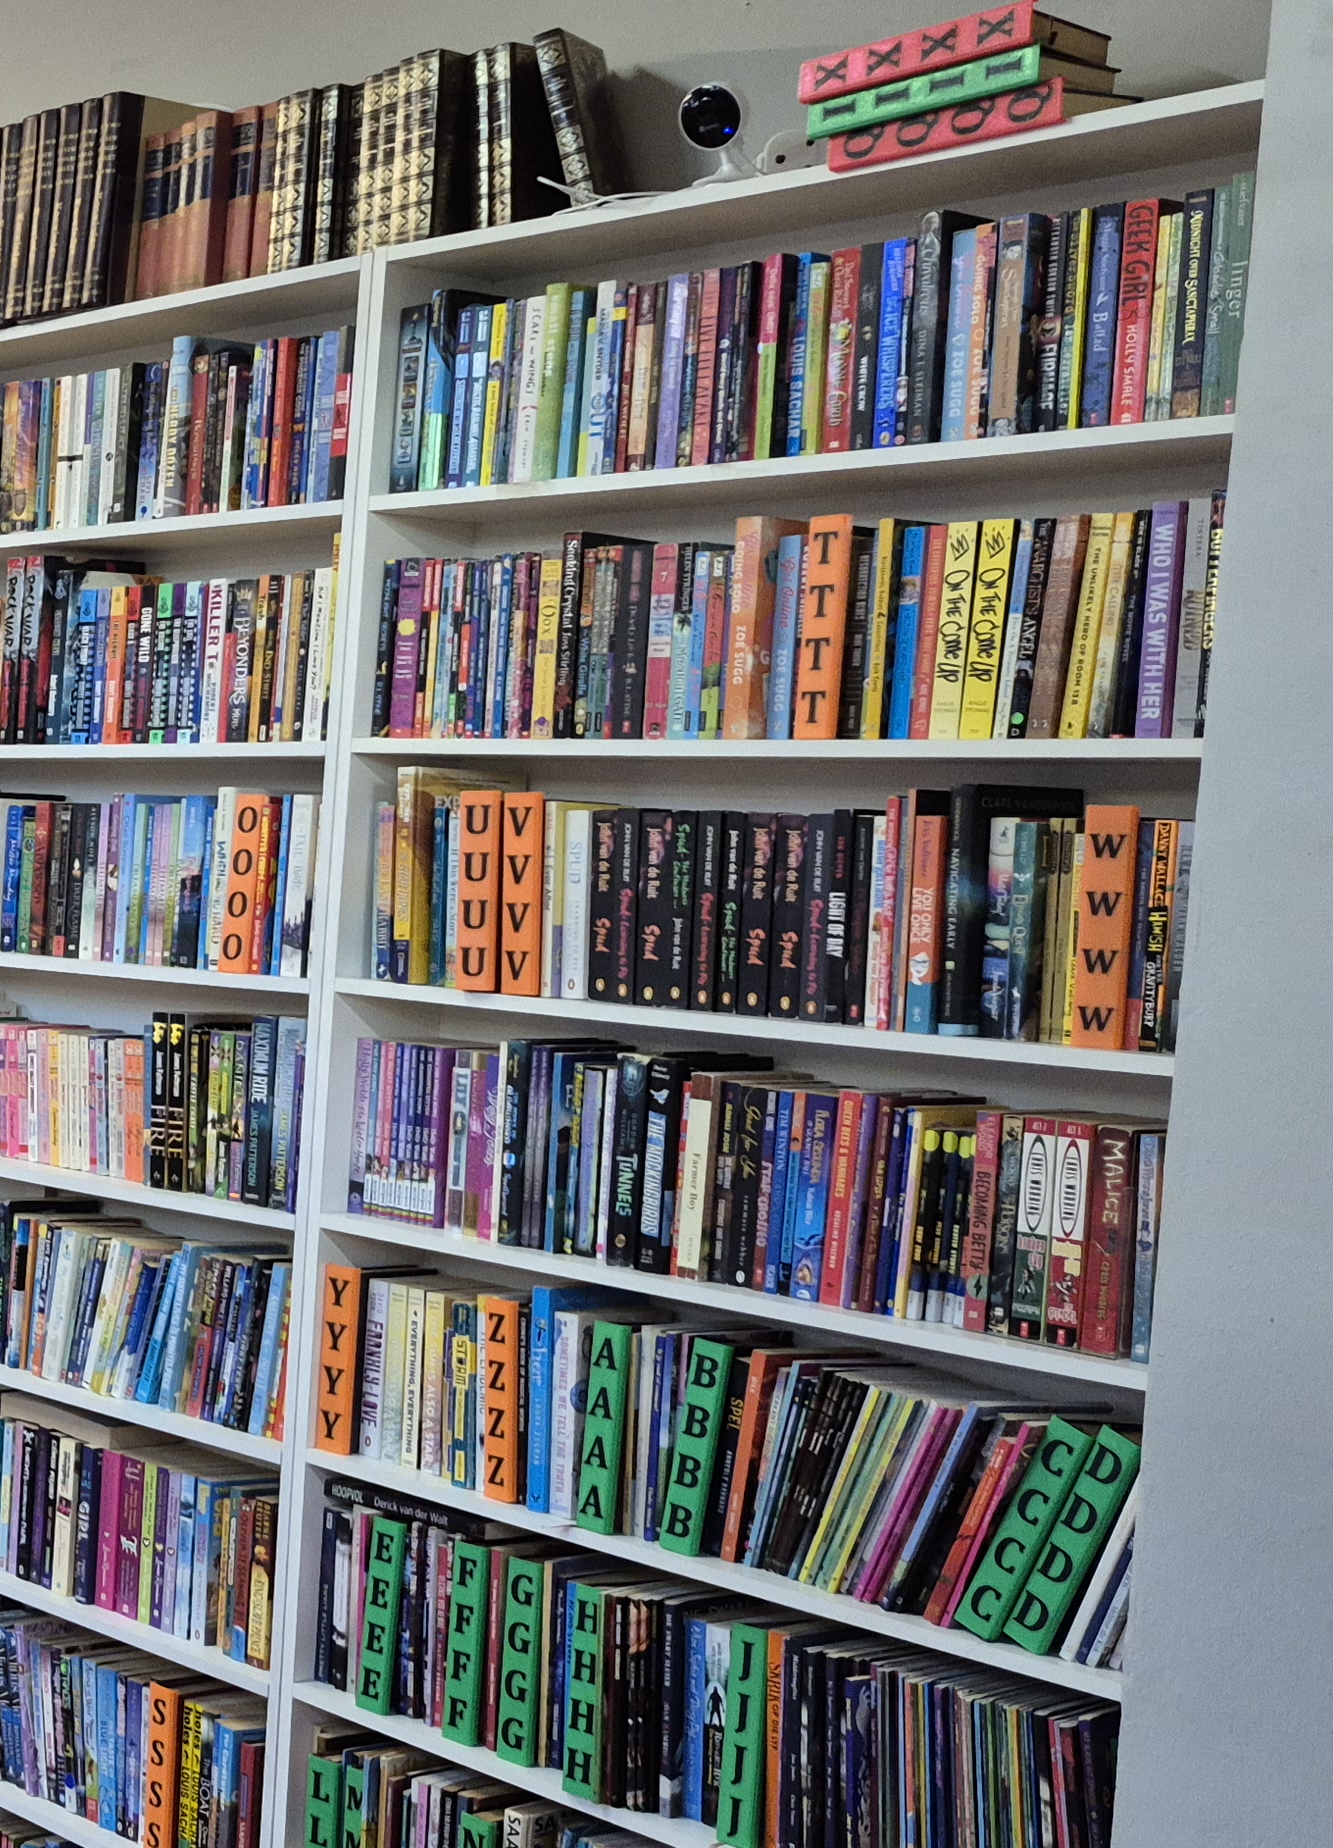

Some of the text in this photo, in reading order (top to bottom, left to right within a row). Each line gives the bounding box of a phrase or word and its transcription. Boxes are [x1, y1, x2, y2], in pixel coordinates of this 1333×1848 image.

[1092, 312, 1108, 352] Ballad
[787, 336, 804, 438] LOUIS SACHAR
[857, 355, 869, 412] WHITE CROW
[949, 350, 963, 418] ZOE SUGG
[1121, 366, 1135, 405] SMALE
[164, 403, 180, 488] NERDY DOZEN
[1091, 547, 1101, 565] THE
[1152, 523, 1174, 567] WHO
[731, 541, 745, 614] GOING SOLO
[1085, 567, 1099, 612] UNLIKELY
[1147, 581, 1169, 623] WAS
[137, 607, 153, 663] GONE WILD
[732, 625, 746, 685] ZOE SUGG
[1079, 644, 1087, 656] OF
[1082, 615, 1091, 640] HERO
[1144, 628, 1166, 675] WITH
[228, 616, 250, 705] BEYONDERS
[576, 638, 589, 695] White Giraffe
[773, 649, 787, 712] ZOE SUGG
[1074, 659, 1085, 687] ROOM
[1140, 682, 1162, 719] HER
[569, 841, 582, 884] SPUD
[1154, 823, 1170, 907] DANNY WALLACE
[826, 891, 846, 958] LIGHT OF DAY
[910, 887, 922, 944] LIVE ONCE
[920, 887, 934, 943] YOU ONLY
[945, 847, 960, 950] NAVIGATING EARLY
[595, 917, 611, 952] Spud
[642, 925, 661, 960] Spud
[746, 928, 766, 966] Spud
[779, 931, 799, 969] Spud
[150, 1104, 167, 1157] FIRE
[167, 1106, 184, 1159] FIRE
[247, 1022, 271, 1187] MAXIMUM RIDE JAMES PATTERSON
[275, 1109, 289, 1190] JAMES PATTERSON
[775, 1108, 789, 1170] TIM WINTON
[983, 1116, 996, 1159] ELEANOR
[615, 1153, 638, 1217] TUNNELS
[641, 1116, 665, 1237] THE MOCKINGBIRDS
[687, 1153, 701, 1212] Farmer Boy
[1101, 1139, 1126, 1225] MALICE
[970, 1171, 991, 1272] BECOMING BETTY
[361, 1391, 378, 1428] LOVE
[405, 1320, 418, 1453] EVERYTHING, EVERYTHING
[422, 1315, 441, 1463] THE SUN IS ALSO A STAR
[555, 1336, 569, 1493] SOMETIMES WE TELL THE TRUTH
[725, 1397, 744, 1432] SPEL
[77, 1500, 90, 1540] GIRL
[181, 1706, 193, 1798] holes LOUIS
[199, 1777, 210, 1817] BOAT
